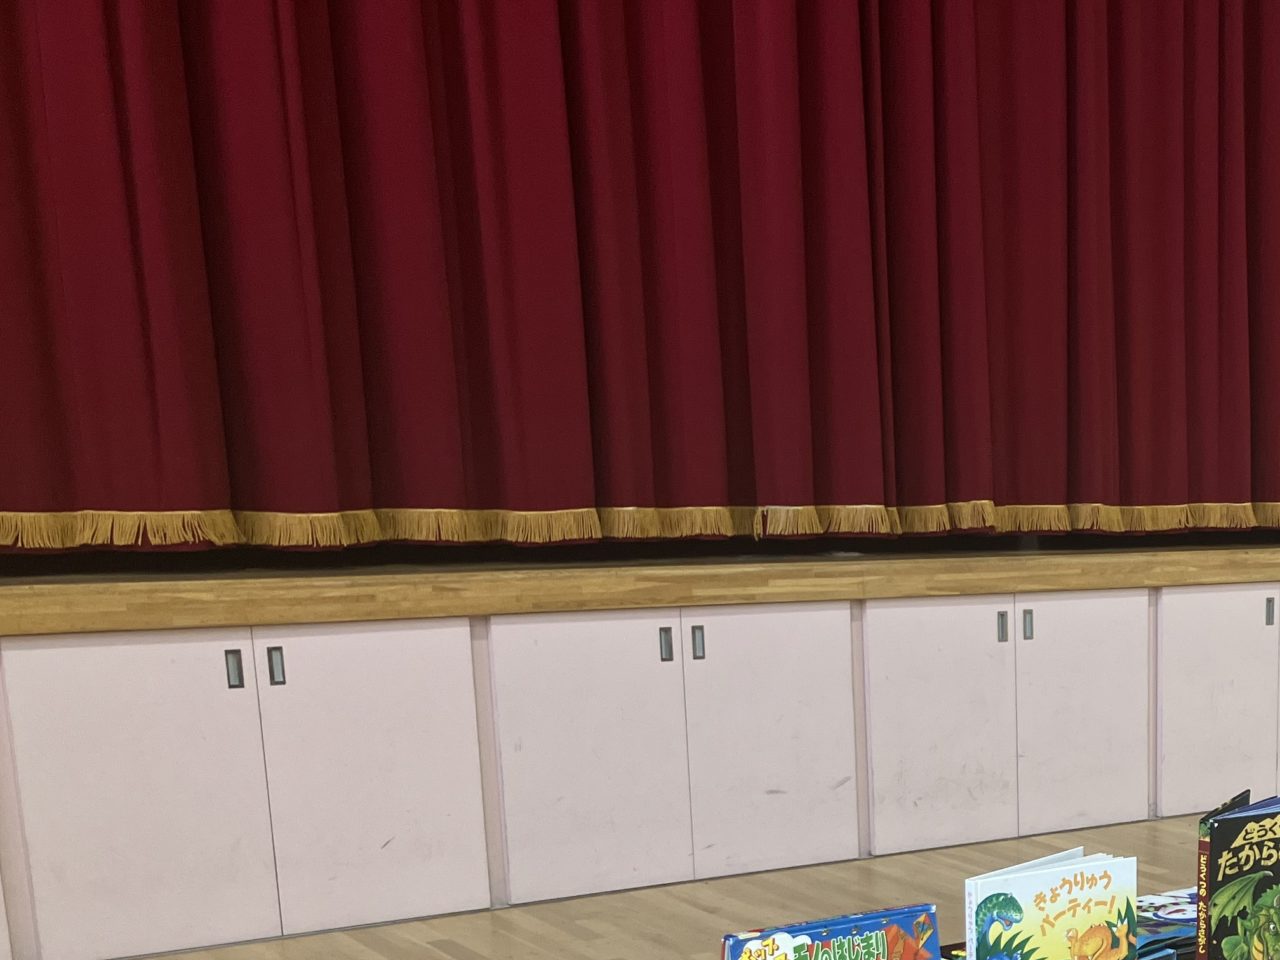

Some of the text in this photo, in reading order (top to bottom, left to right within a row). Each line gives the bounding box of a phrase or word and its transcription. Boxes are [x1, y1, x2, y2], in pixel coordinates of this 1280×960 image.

[1033, 870, 1113, 912] きょうりゅう
[1040, 895, 1117, 937] パーティー!
